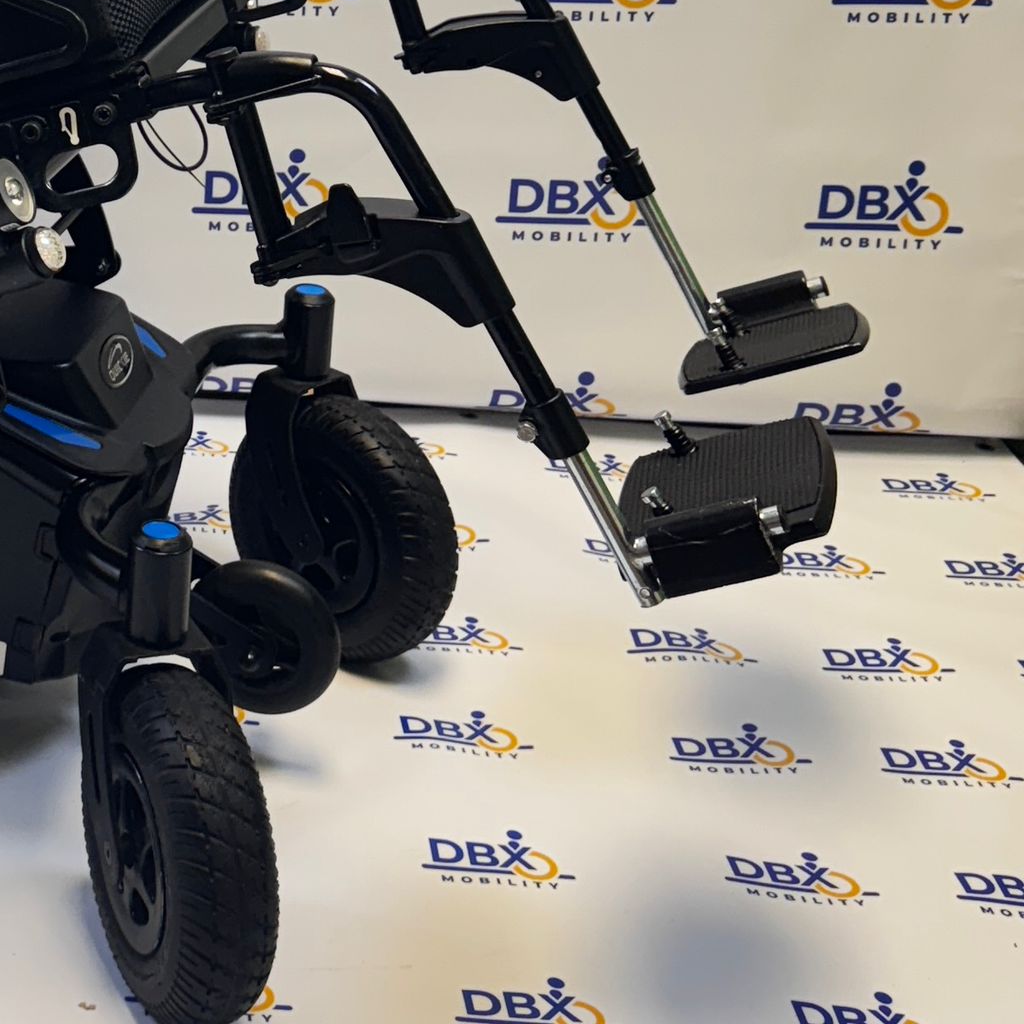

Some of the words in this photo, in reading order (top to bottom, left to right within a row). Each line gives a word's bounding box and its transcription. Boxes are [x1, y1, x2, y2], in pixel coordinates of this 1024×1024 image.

[556, 10, 655, 23] BILITY
[848, 12, 969, 23] MOBILITY
[204, 169, 309, 205] DX
[508, 179, 614, 215] DBX
[818, 185, 929, 221] DBX
[512, 231, 630, 242] MOBILITY
[820, 237, 941, 250] MOBILITY
[201, 376, 255, 393] DB
[490, 388, 604, 413] DX
[794, 402, 902, 429] DBX
[882, 473, 964, 495] DBX
[173, 509, 225, 524] BX
[783, 552, 848, 570] DBX
[782, 570, 869, 580] MOBILITY
[431, 625, 489, 645] BX
[627, 628, 717, 652] DBX
[645, 655, 744, 667] MOBILITY
[818, 648, 911, 669] DBX
[398, 714, 500, 740] DBX
[411, 743, 518, 759] MOBILITY
[672, 736, 776, 758] DBX
[689, 766, 797, 774] MOBILITY
[880, 748, 986, 777] DBX
[901, 777, 1013, 789] MOBILITY
[428, 836, 536, 870] DBX
[726, 854, 837, 889] DBX
[442, 875, 557, 889] MOBILITY
[955, 873, 1024, 900] DB
[747, 888, 863, 905] MOBILITY
[462, 989, 582, 1022] DBX
